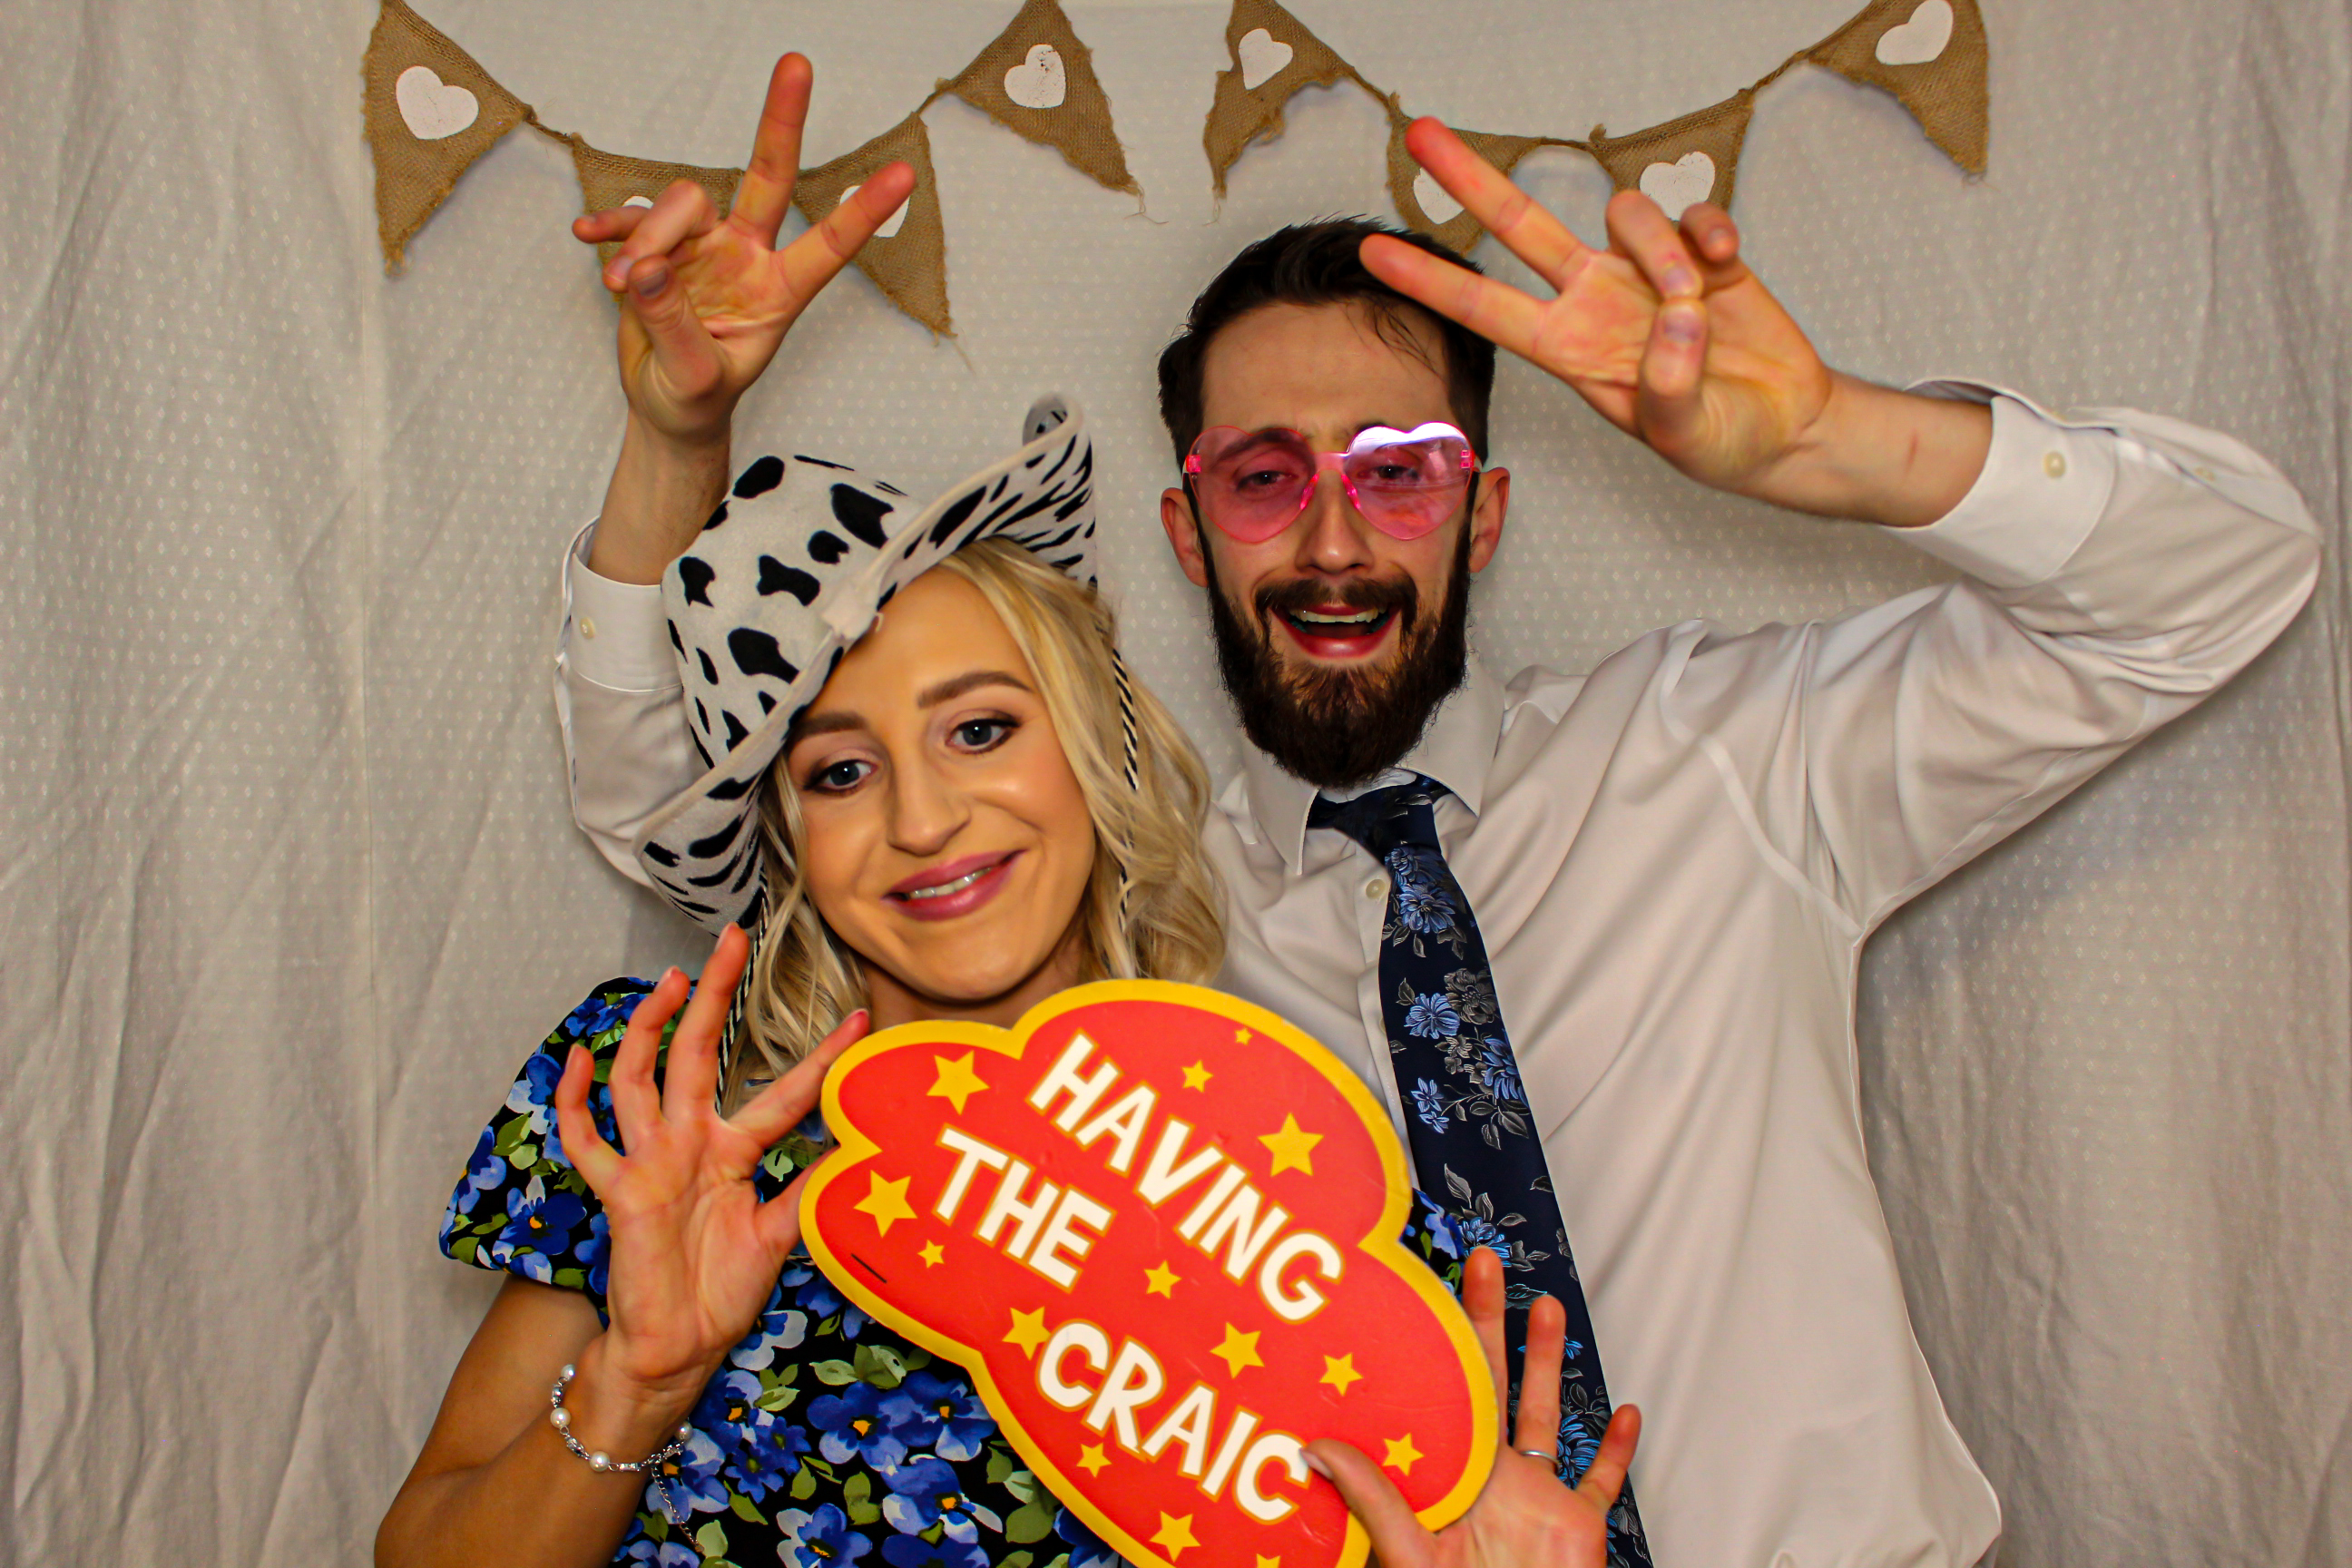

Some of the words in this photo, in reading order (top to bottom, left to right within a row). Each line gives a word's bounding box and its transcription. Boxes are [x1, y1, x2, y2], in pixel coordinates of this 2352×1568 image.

[933, 1127, 1113, 1290] THE
[1029, 1032, 1343, 1322] HAVING
[1036, 1321, 1308, 1523] CRAIC
